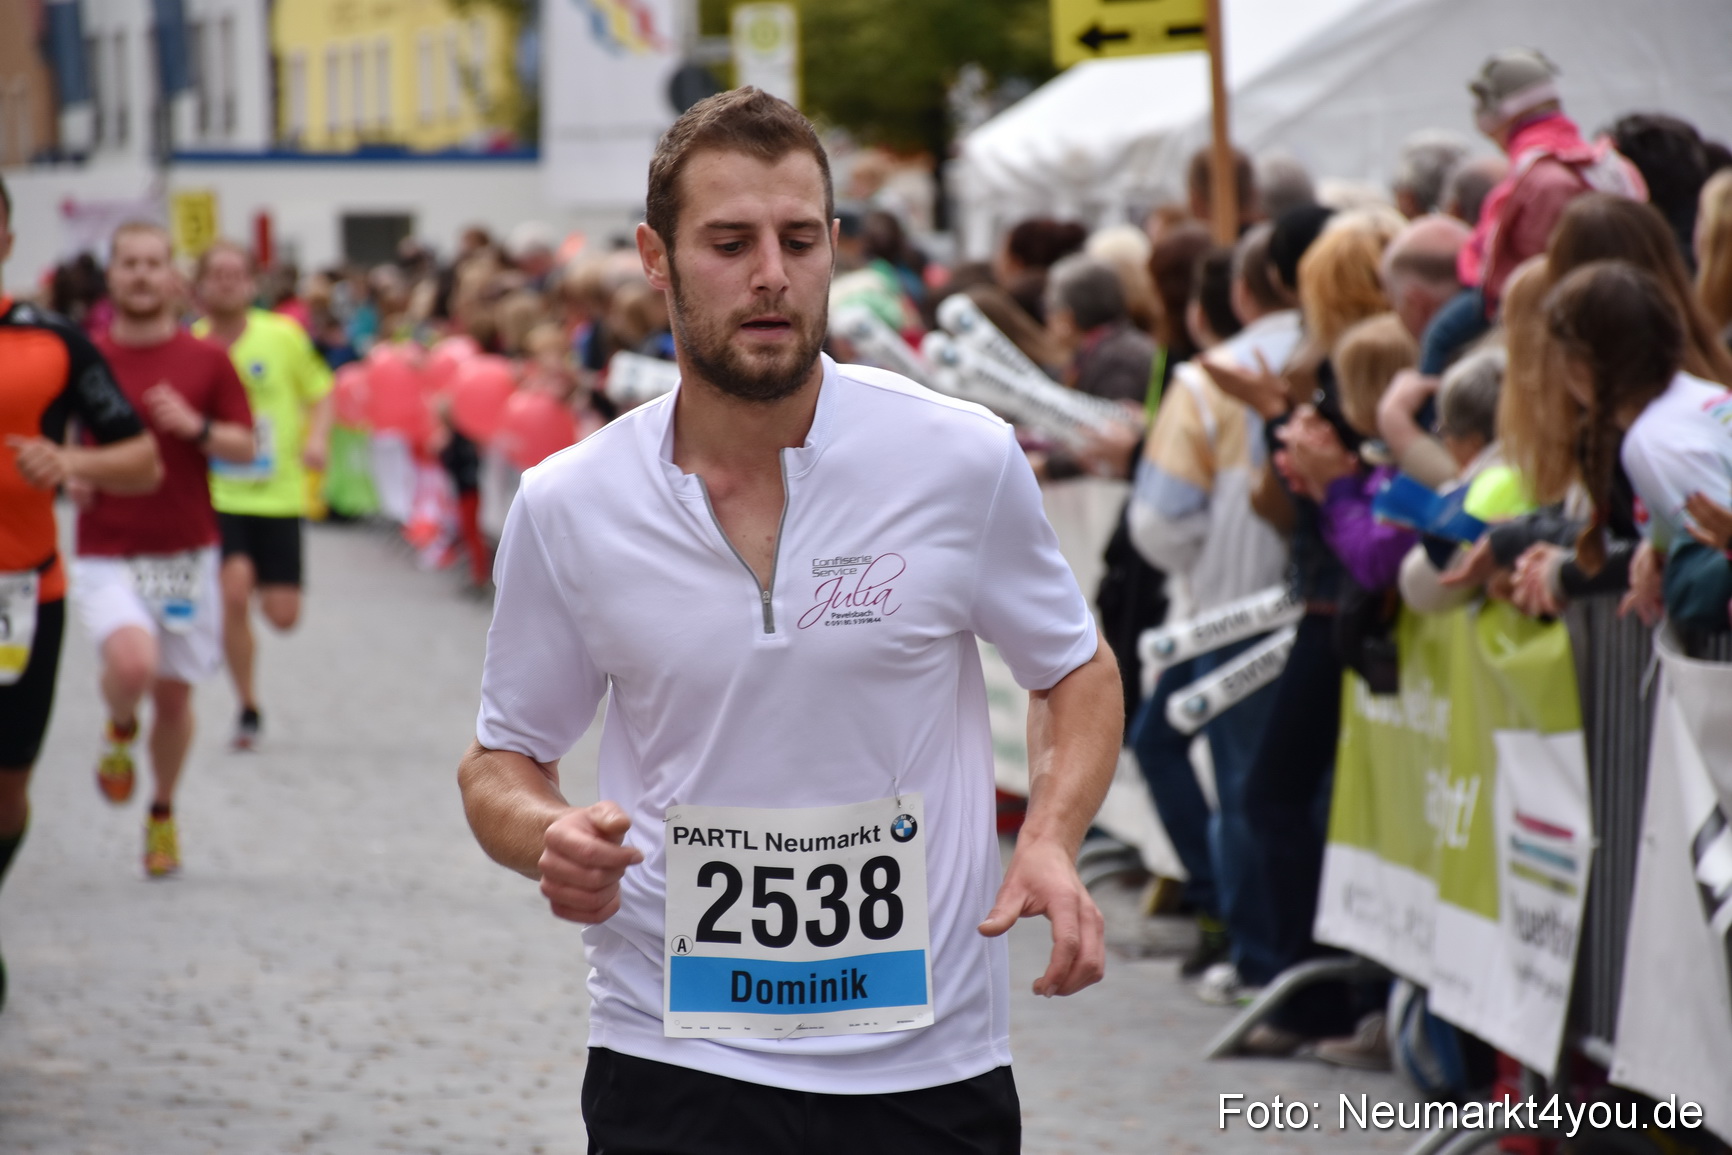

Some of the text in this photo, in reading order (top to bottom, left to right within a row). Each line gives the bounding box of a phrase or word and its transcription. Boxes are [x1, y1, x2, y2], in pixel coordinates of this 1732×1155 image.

[812, 555, 872, 567] Confiserie
[812, 567, 857, 578] Service
[797, 552, 906, 630] Julia
[673, 825, 881, 853] PARTL Neumarkt
[695, 855, 904, 948] 2538
[677, 938, 687, 953] A
[731, 968, 868, 1005] Dominik
